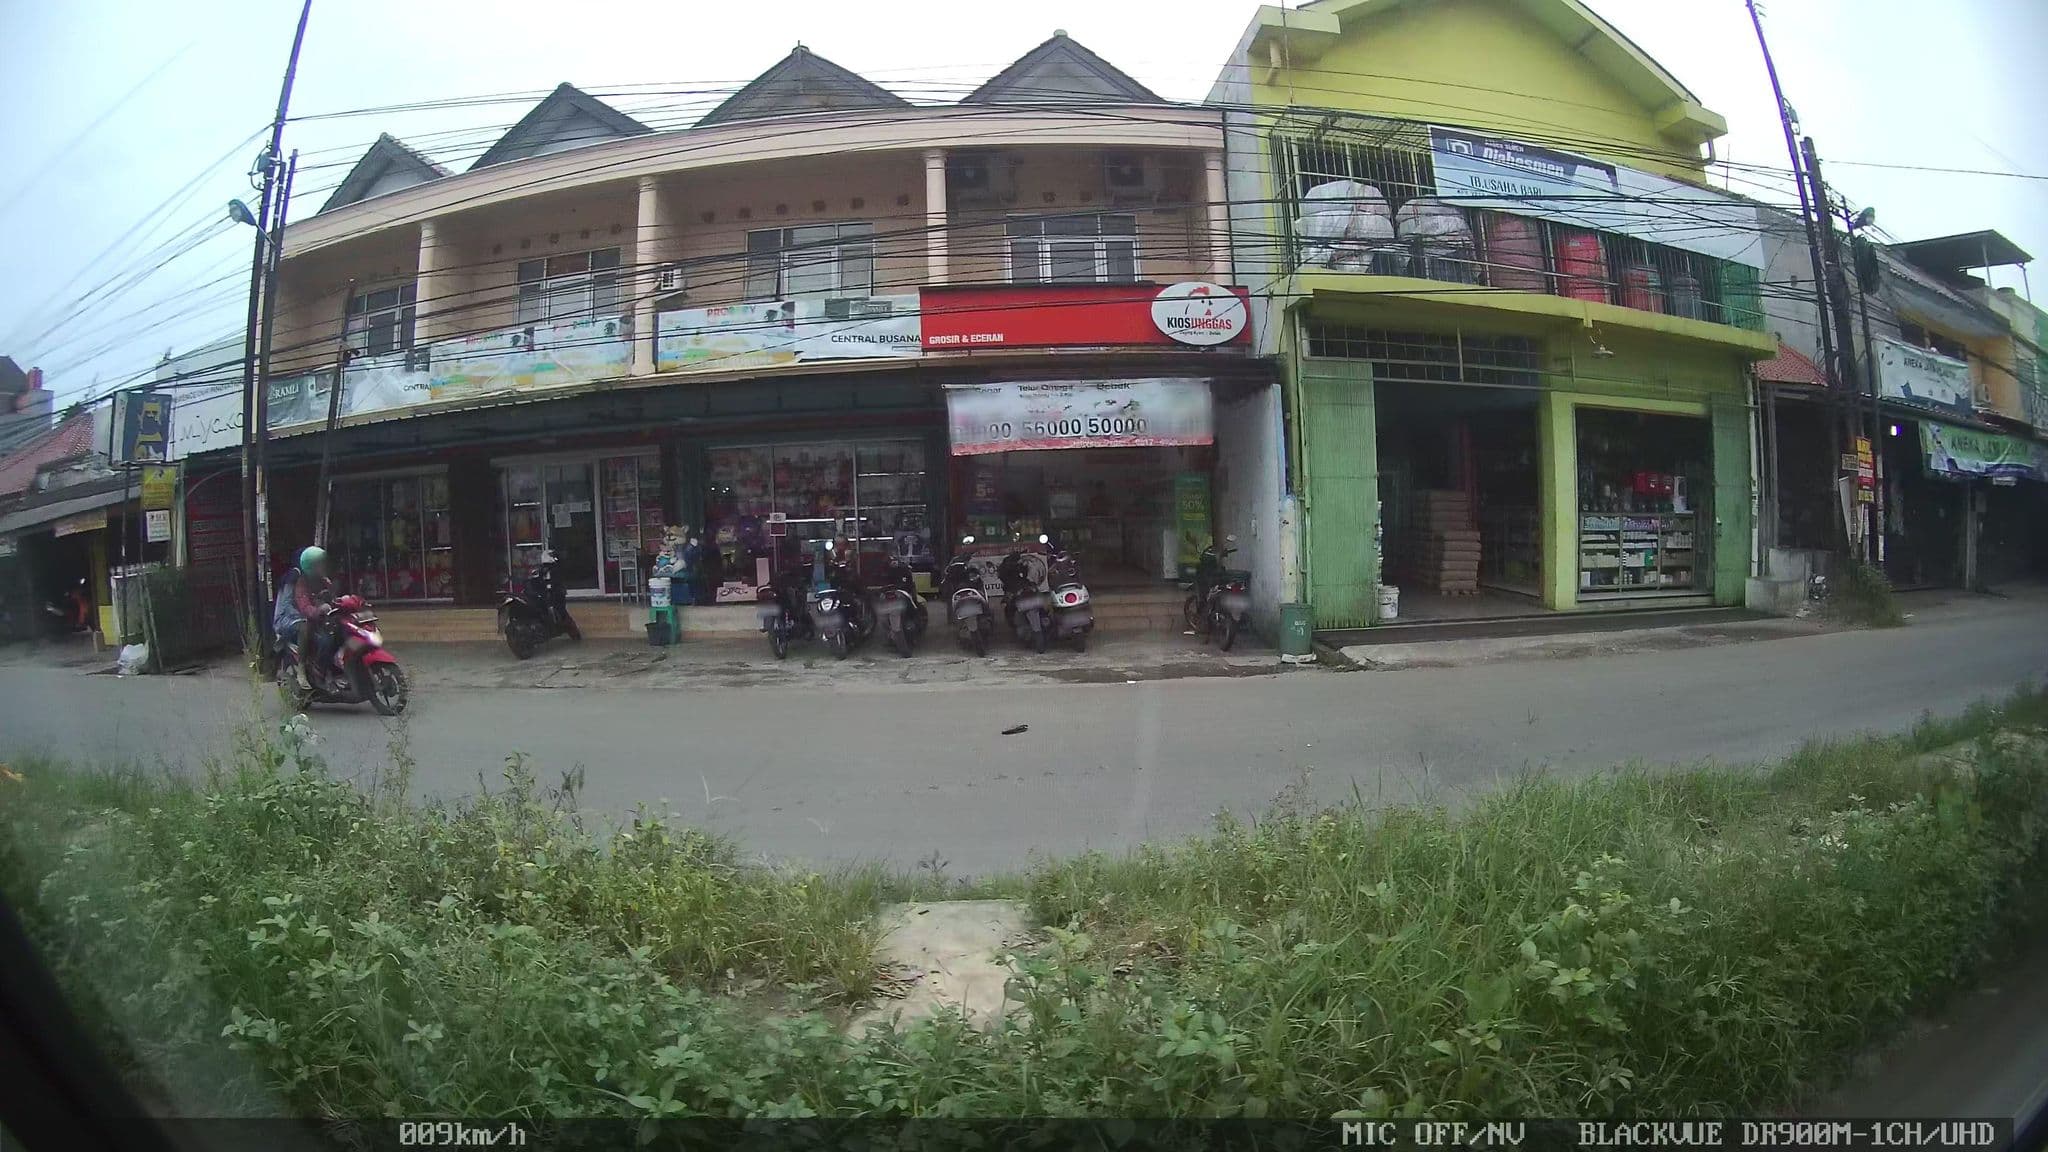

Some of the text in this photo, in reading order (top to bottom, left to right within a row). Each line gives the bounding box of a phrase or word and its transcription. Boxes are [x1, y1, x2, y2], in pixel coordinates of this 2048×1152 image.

[1166, 316, 1232, 331] KIOSUNGGAS
[831, 334, 922, 344] CENTRAL BUSANA
[929, 333, 1004, 345] GROSIR & ECERAN
[1022, 419, 1081, 436] 56000
[1088, 418, 1147, 434] 50000
